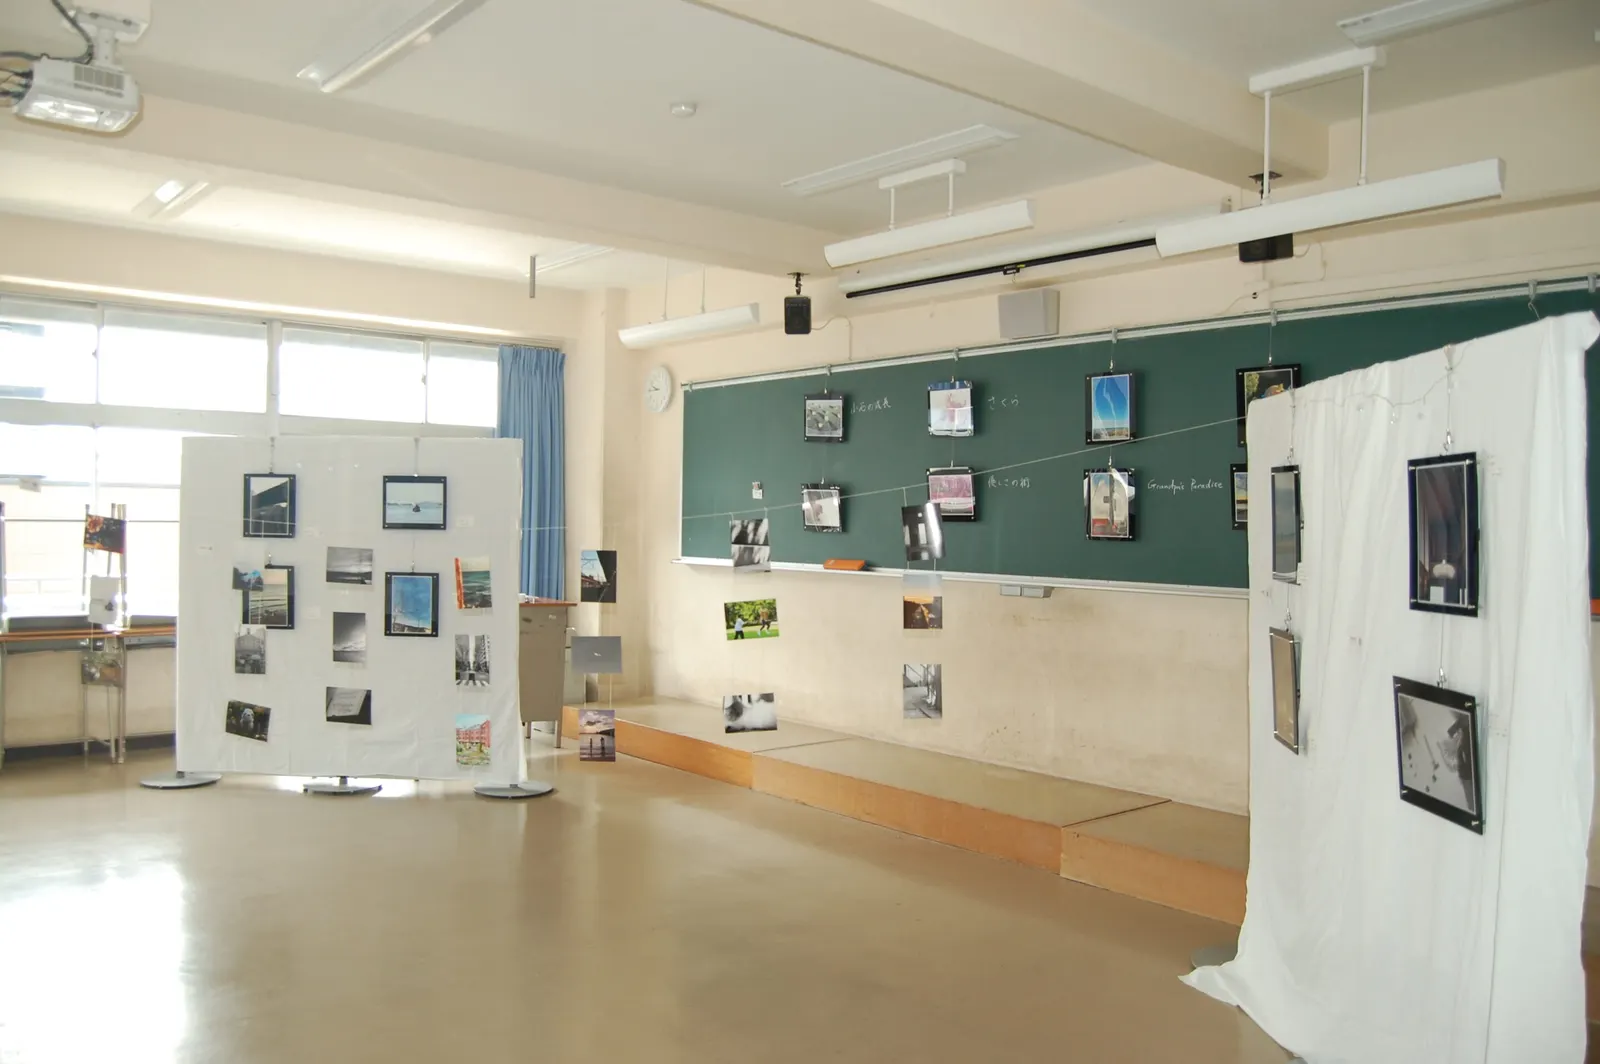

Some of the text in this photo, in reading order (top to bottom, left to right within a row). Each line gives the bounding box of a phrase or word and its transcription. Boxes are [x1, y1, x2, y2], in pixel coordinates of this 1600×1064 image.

[988, 394, 1020, 411] さくら
[1147, 477, 1224, 496] Grandpa's Paradise
